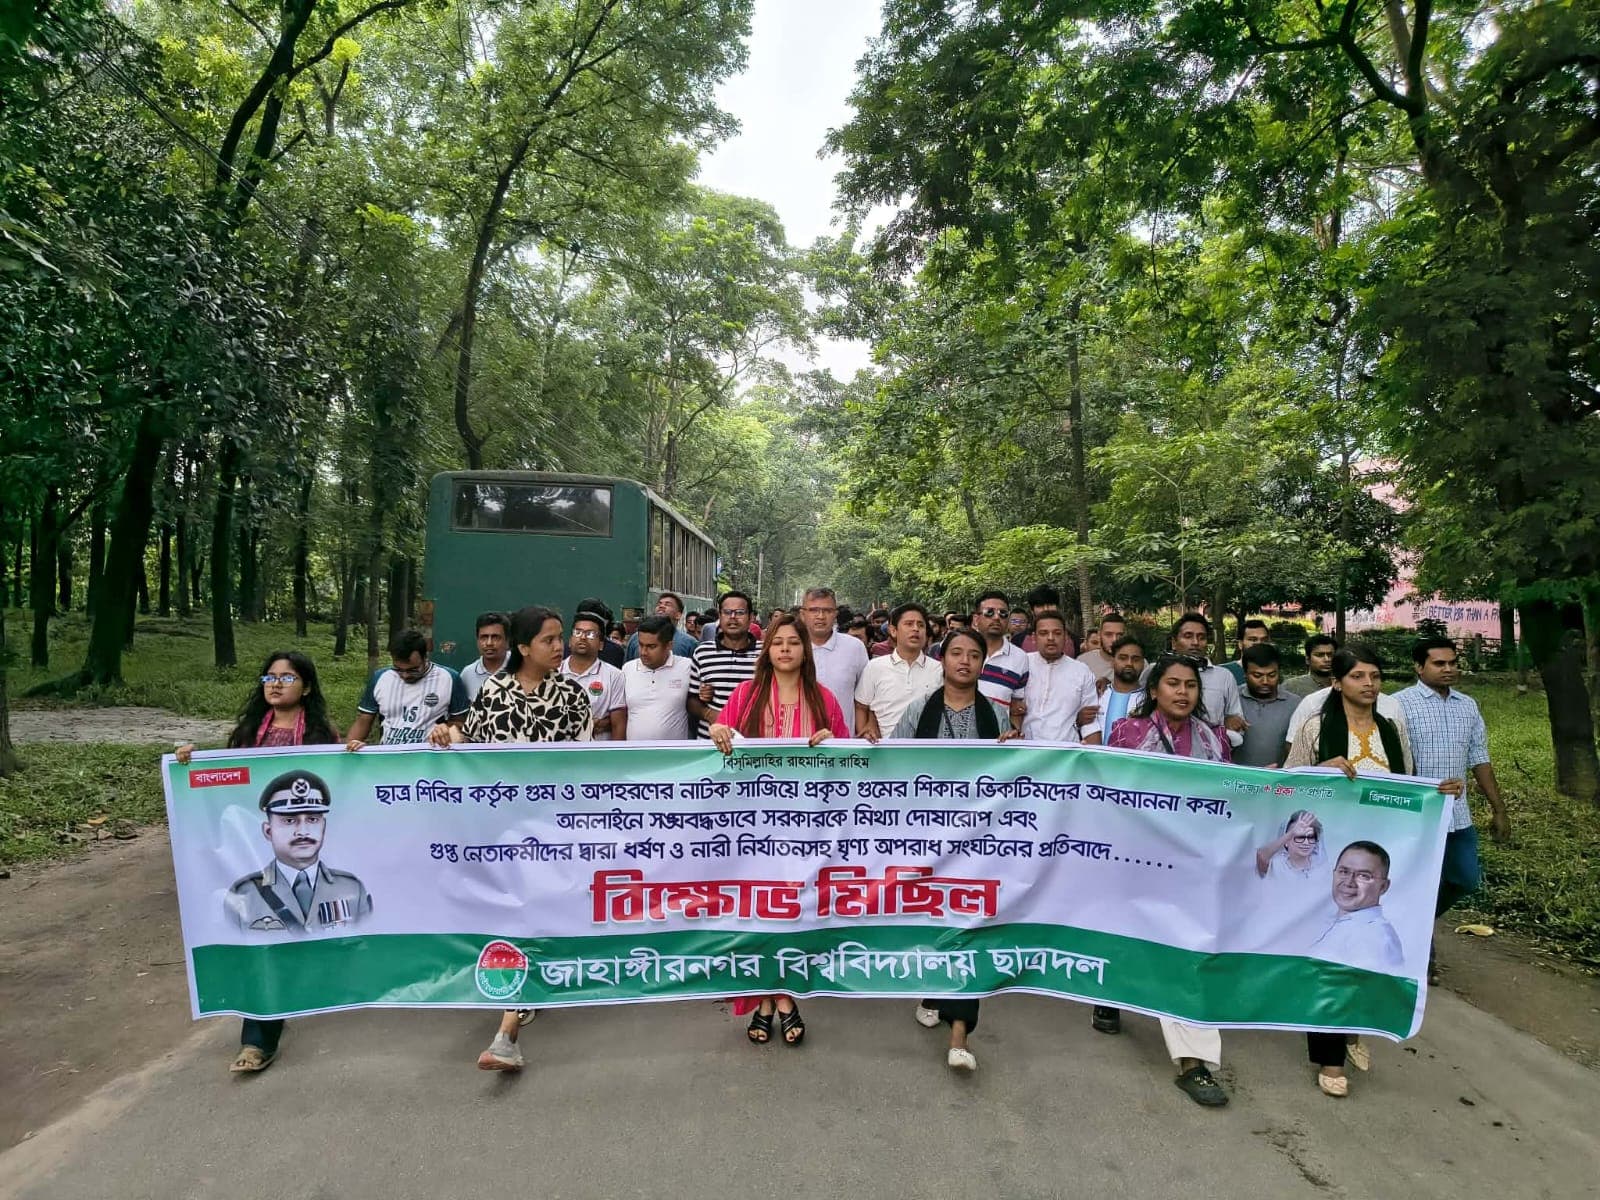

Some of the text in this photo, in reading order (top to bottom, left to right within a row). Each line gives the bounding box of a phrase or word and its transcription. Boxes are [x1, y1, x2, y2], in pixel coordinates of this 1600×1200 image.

[787, 754, 835, 769] রাহমানির
[839, 753, 869, 769] রাহিম
[195, 771, 241, 783] বাংলাদেশ
[375, 774, 1232, 819] ছাত্র শিবির কর্তৃক গুম ও অপহরণের নাটক সাজিয়ে প্রকৃত গুমের শিকার ভিকটিমদের অবমাননা করা,
[556, 808, 644, 831] অনলাইনে
[762, 809, 848, 828] সরকারকে
[853, 803, 900, 827] মিথ্যা
[906, 809, 993, 828] দোষারোপ
[998, 811, 1038, 831] এবং
[430, 842, 459, 863] গুপ্ত
[463, 836, 574, 863] নেতাকর্মীদের
[578, 842, 617, 862] দ্বারা
[623, 837, 665, 859] ধর্ষণ
[670, 843, 684, 859] ও
[690, 834, 731, 858] নারী
[736, 833, 833, 858] নির্যাতনসহ
[837, 838, 869, 862] ঘৃণ্য
[874, 838, 942, 858] অপরাধ
[947, 834, 1033, 859] সংঘটনের
[589, 865, 1002, 924] বিক্ষোভ মিছিল
[536, 947, 765, 989] জাহাঙ্গীরনগর
[775, 941, 979, 983] বিশ্ববিদ্যালয়
[988, 944, 1111, 985] ছাত্রদল
